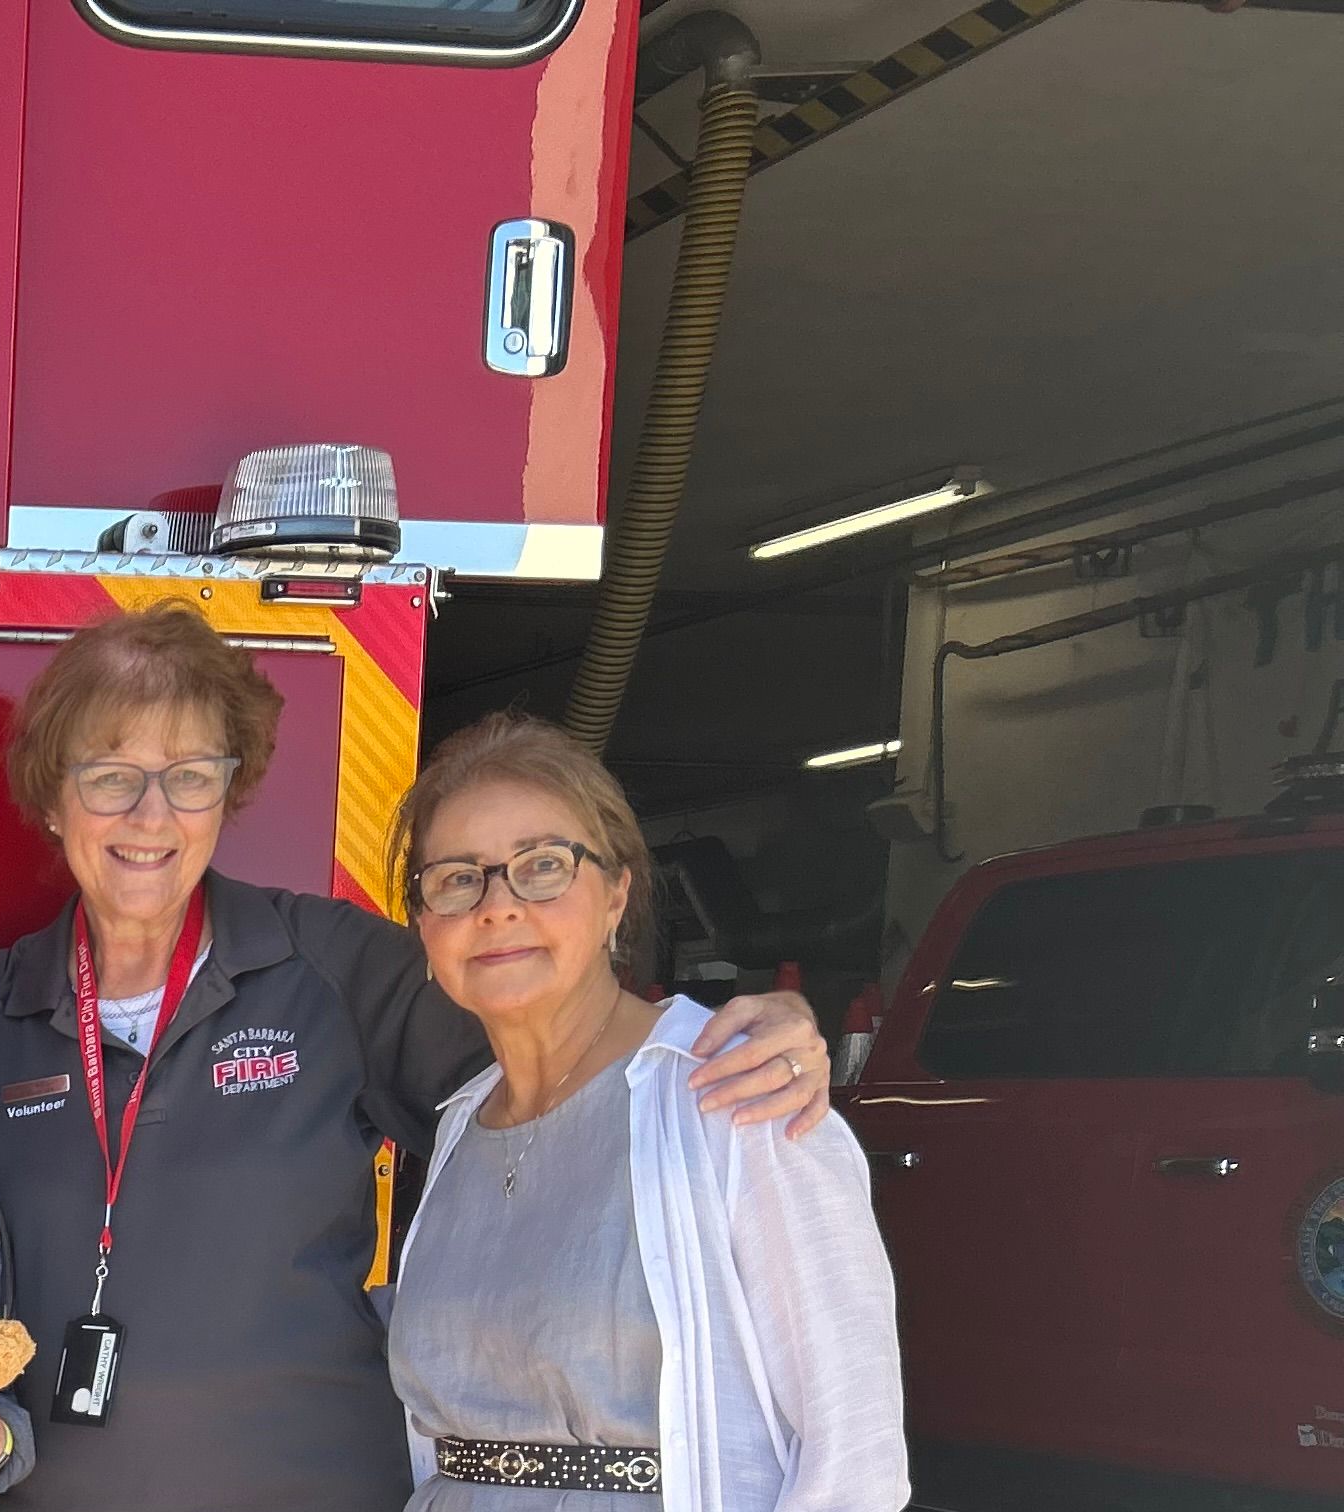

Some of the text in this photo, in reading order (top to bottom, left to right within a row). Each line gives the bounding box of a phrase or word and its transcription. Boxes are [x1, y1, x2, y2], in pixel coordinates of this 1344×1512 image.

[80, 974, 92, 998] Fire
[81, 997, 96, 1023] City
[84, 1024, 99, 1078] Barbara
[211, 1027, 295, 1054] SANTA BARBARA
[233, 1045, 274, 1058] CITY
[213, 1050, 300, 1088] FIRE
[222, 1074, 296, 1096] DEPARTMENT
[6, 1099, 66, 1118] Volunteer
[90, 1078, 102, 1119] Santa
[99, 1339, 112, 1369] CATHY
